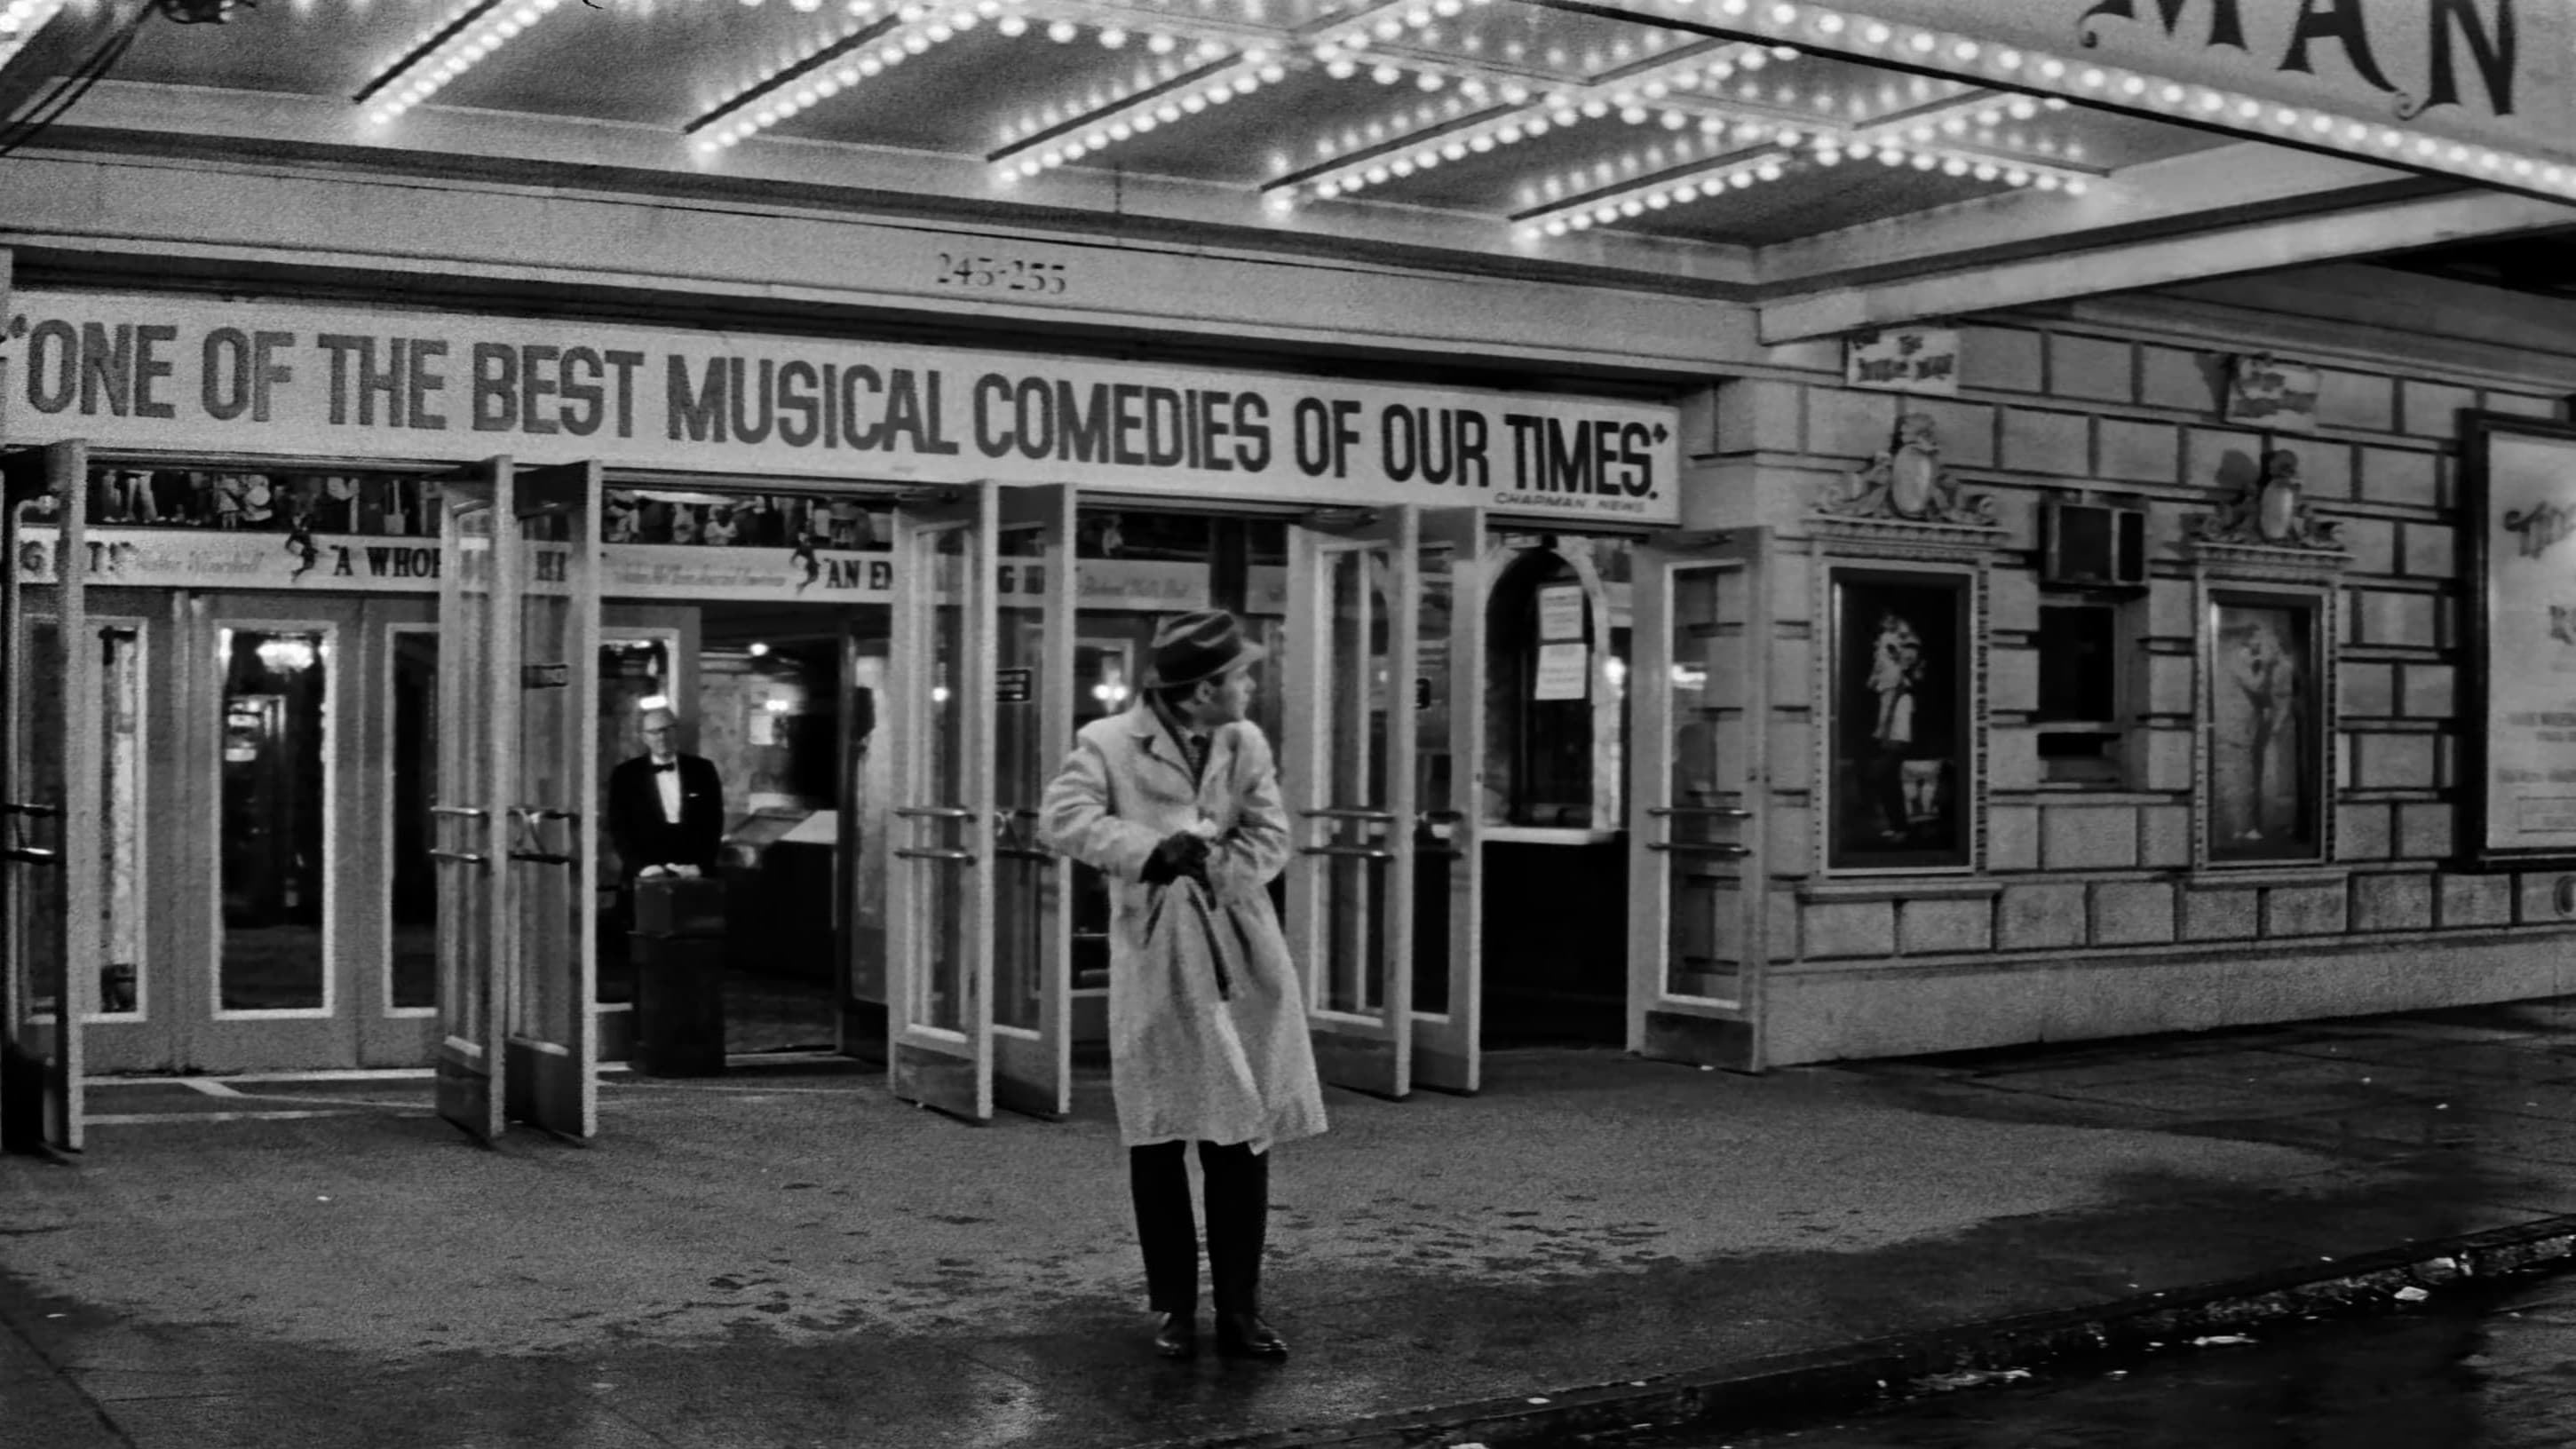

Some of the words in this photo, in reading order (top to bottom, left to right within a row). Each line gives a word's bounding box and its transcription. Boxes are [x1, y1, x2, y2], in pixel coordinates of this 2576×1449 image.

[937, 252, 1066, 295] 245-255
[201, 326, 296, 422] OF
[316, 332, 448, 430] THE
[472, 341, 645, 438] BEST
[666, 353, 960, 455] MUSICAL
[973, 370, 1272, 474] COMEDIES
[1293, 396, 1362, 479] OF
[1380, 403, 1490, 487] OUR
[1494, 491, 1586, 509] CHAPMAN
